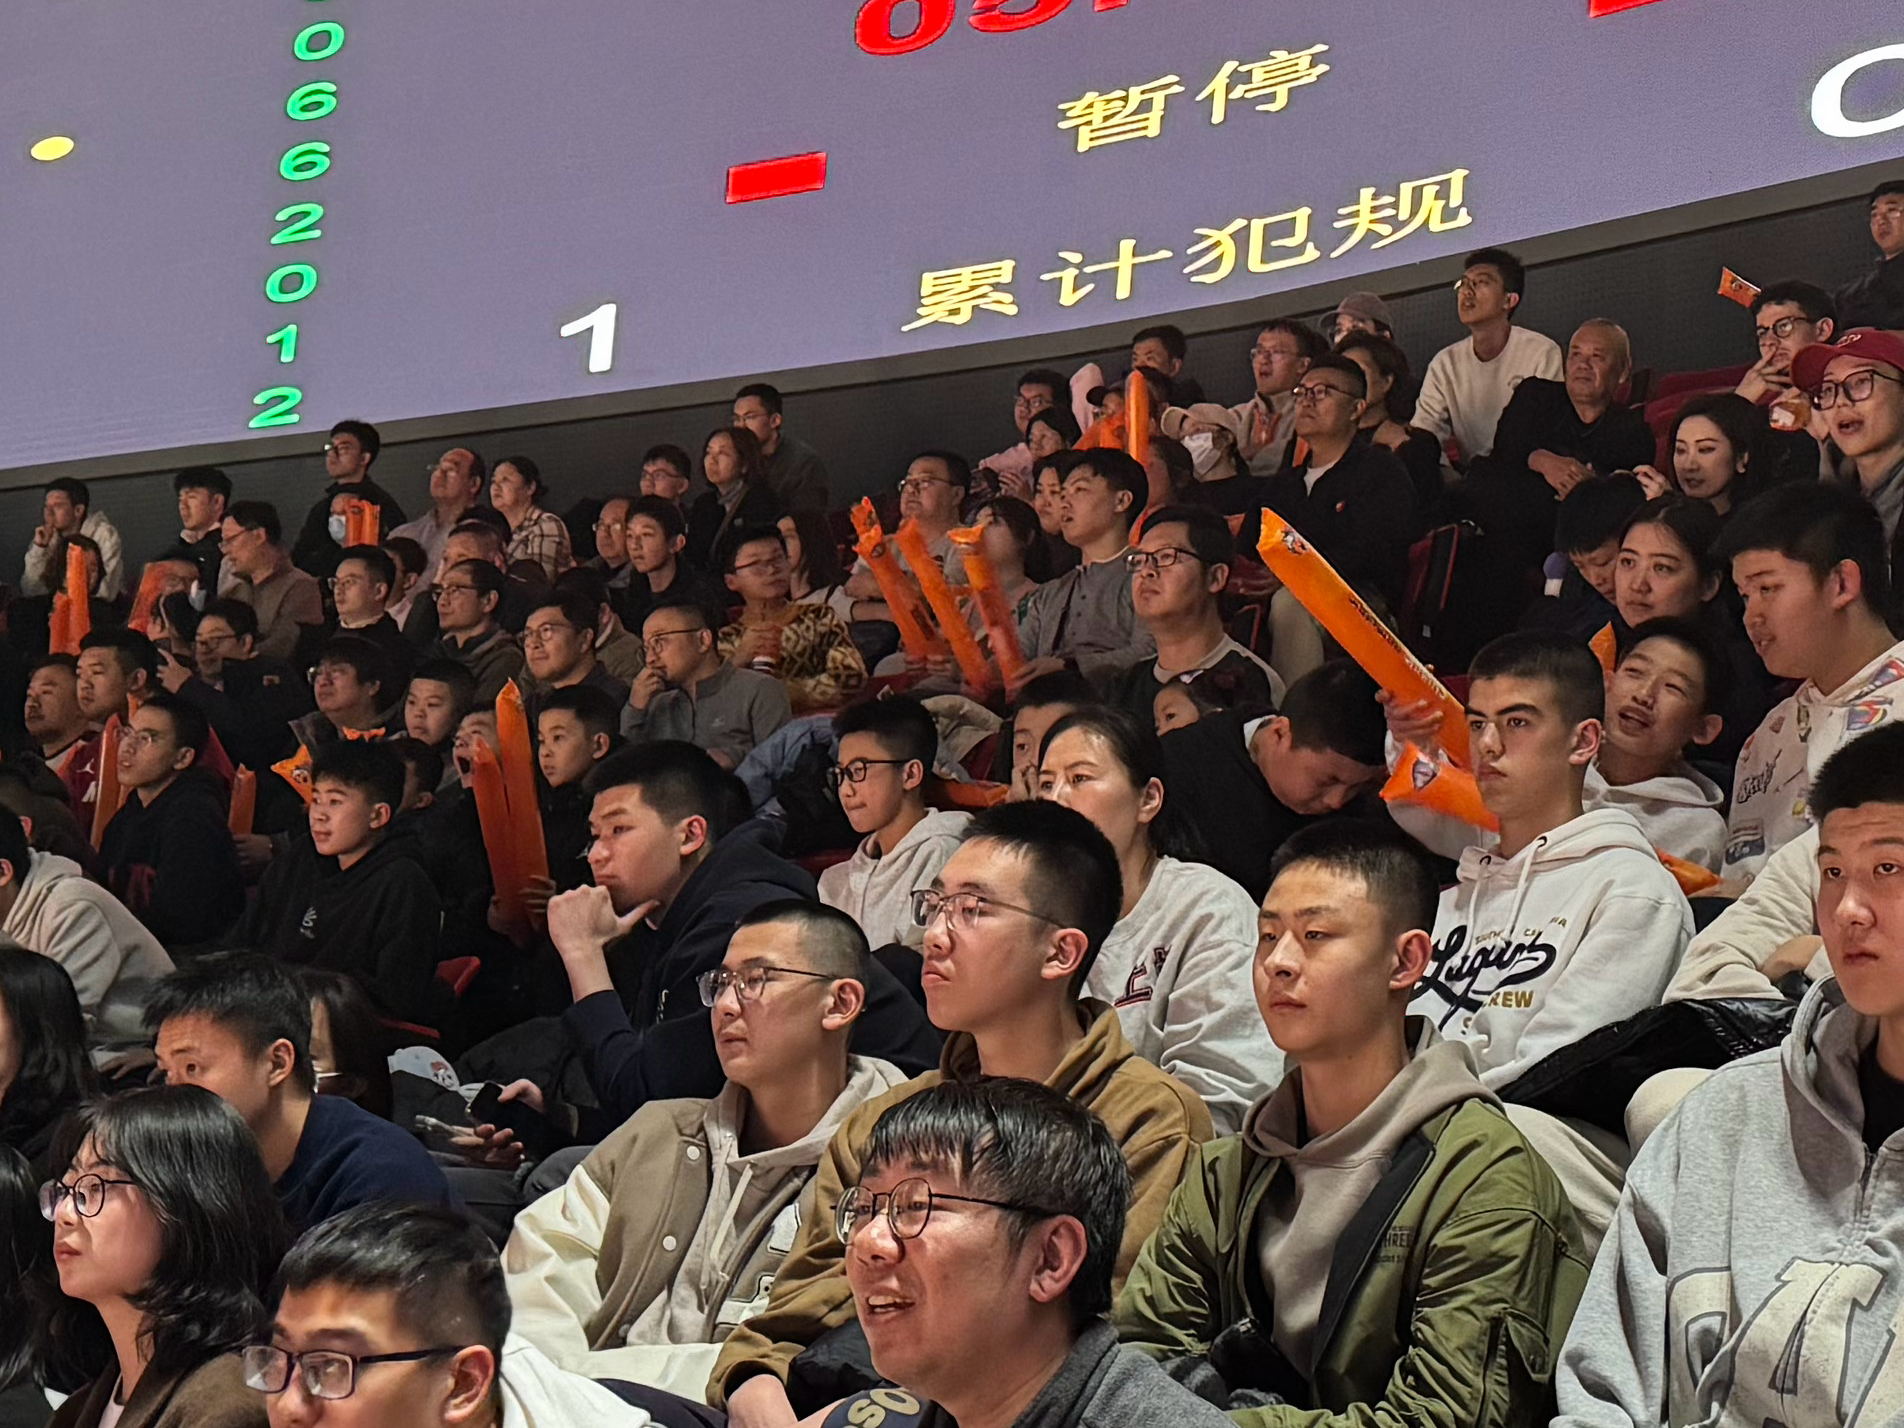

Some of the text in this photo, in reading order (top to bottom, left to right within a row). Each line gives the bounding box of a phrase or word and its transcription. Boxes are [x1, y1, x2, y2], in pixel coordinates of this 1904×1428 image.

[294, 22, 344, 60] 0
[287, 82, 337, 120] 6
[1059, 45, 1332, 152] 暂停
[280, 142, 330, 180] 6
[272, 203, 324, 244] 2
[266, 264, 317, 302] 0
[558, 303, 619, 373] 1
[902, 167, 1473, 332] 累计犯规
[267, 324, 297, 362] 1
[250, 387, 302, 428] 2
[1483, 989, 1535, 1009] REW
